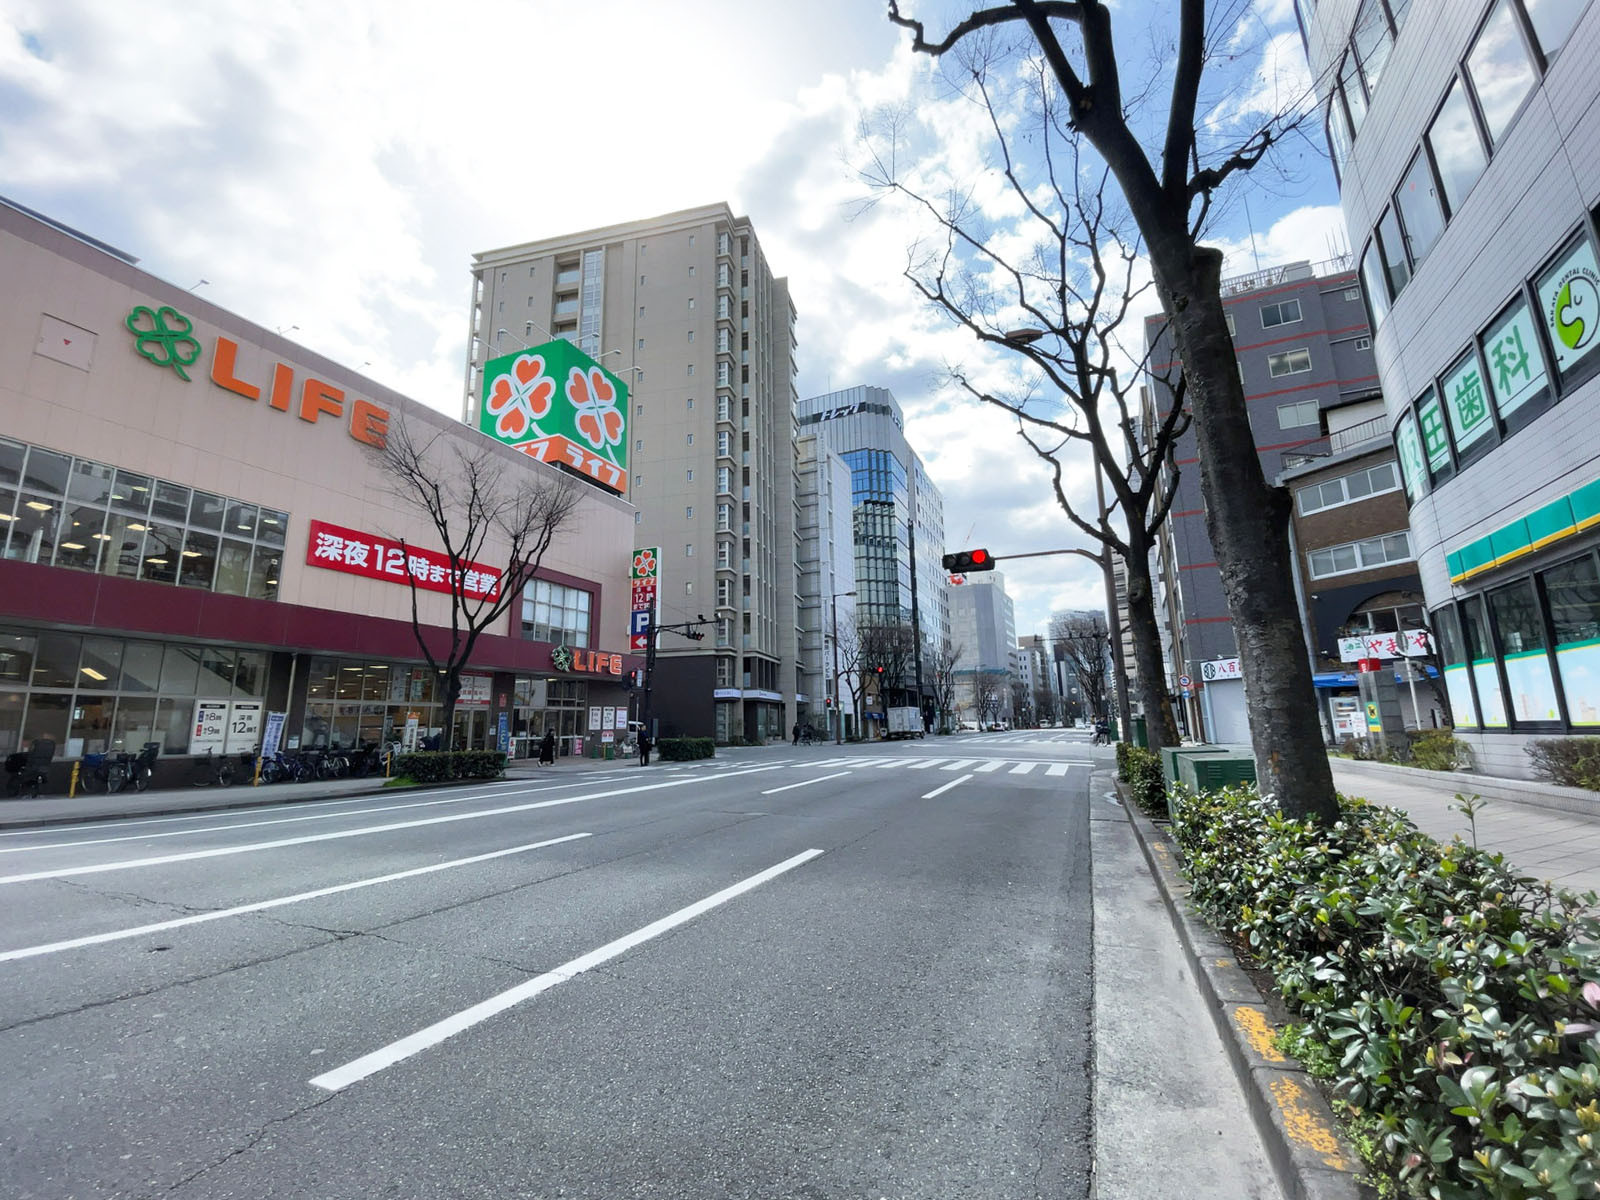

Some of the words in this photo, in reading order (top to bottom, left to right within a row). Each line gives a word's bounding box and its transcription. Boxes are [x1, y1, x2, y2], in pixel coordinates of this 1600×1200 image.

[211, 336, 391, 450] LIFE
[566, 443, 621, 487] ライフ
[636, 613, 650, 632] P
[1368, 634, 1428, 654] やまや
[573, 649, 623, 675] LIFE
[1218, 661, 1241, 673] 八百
